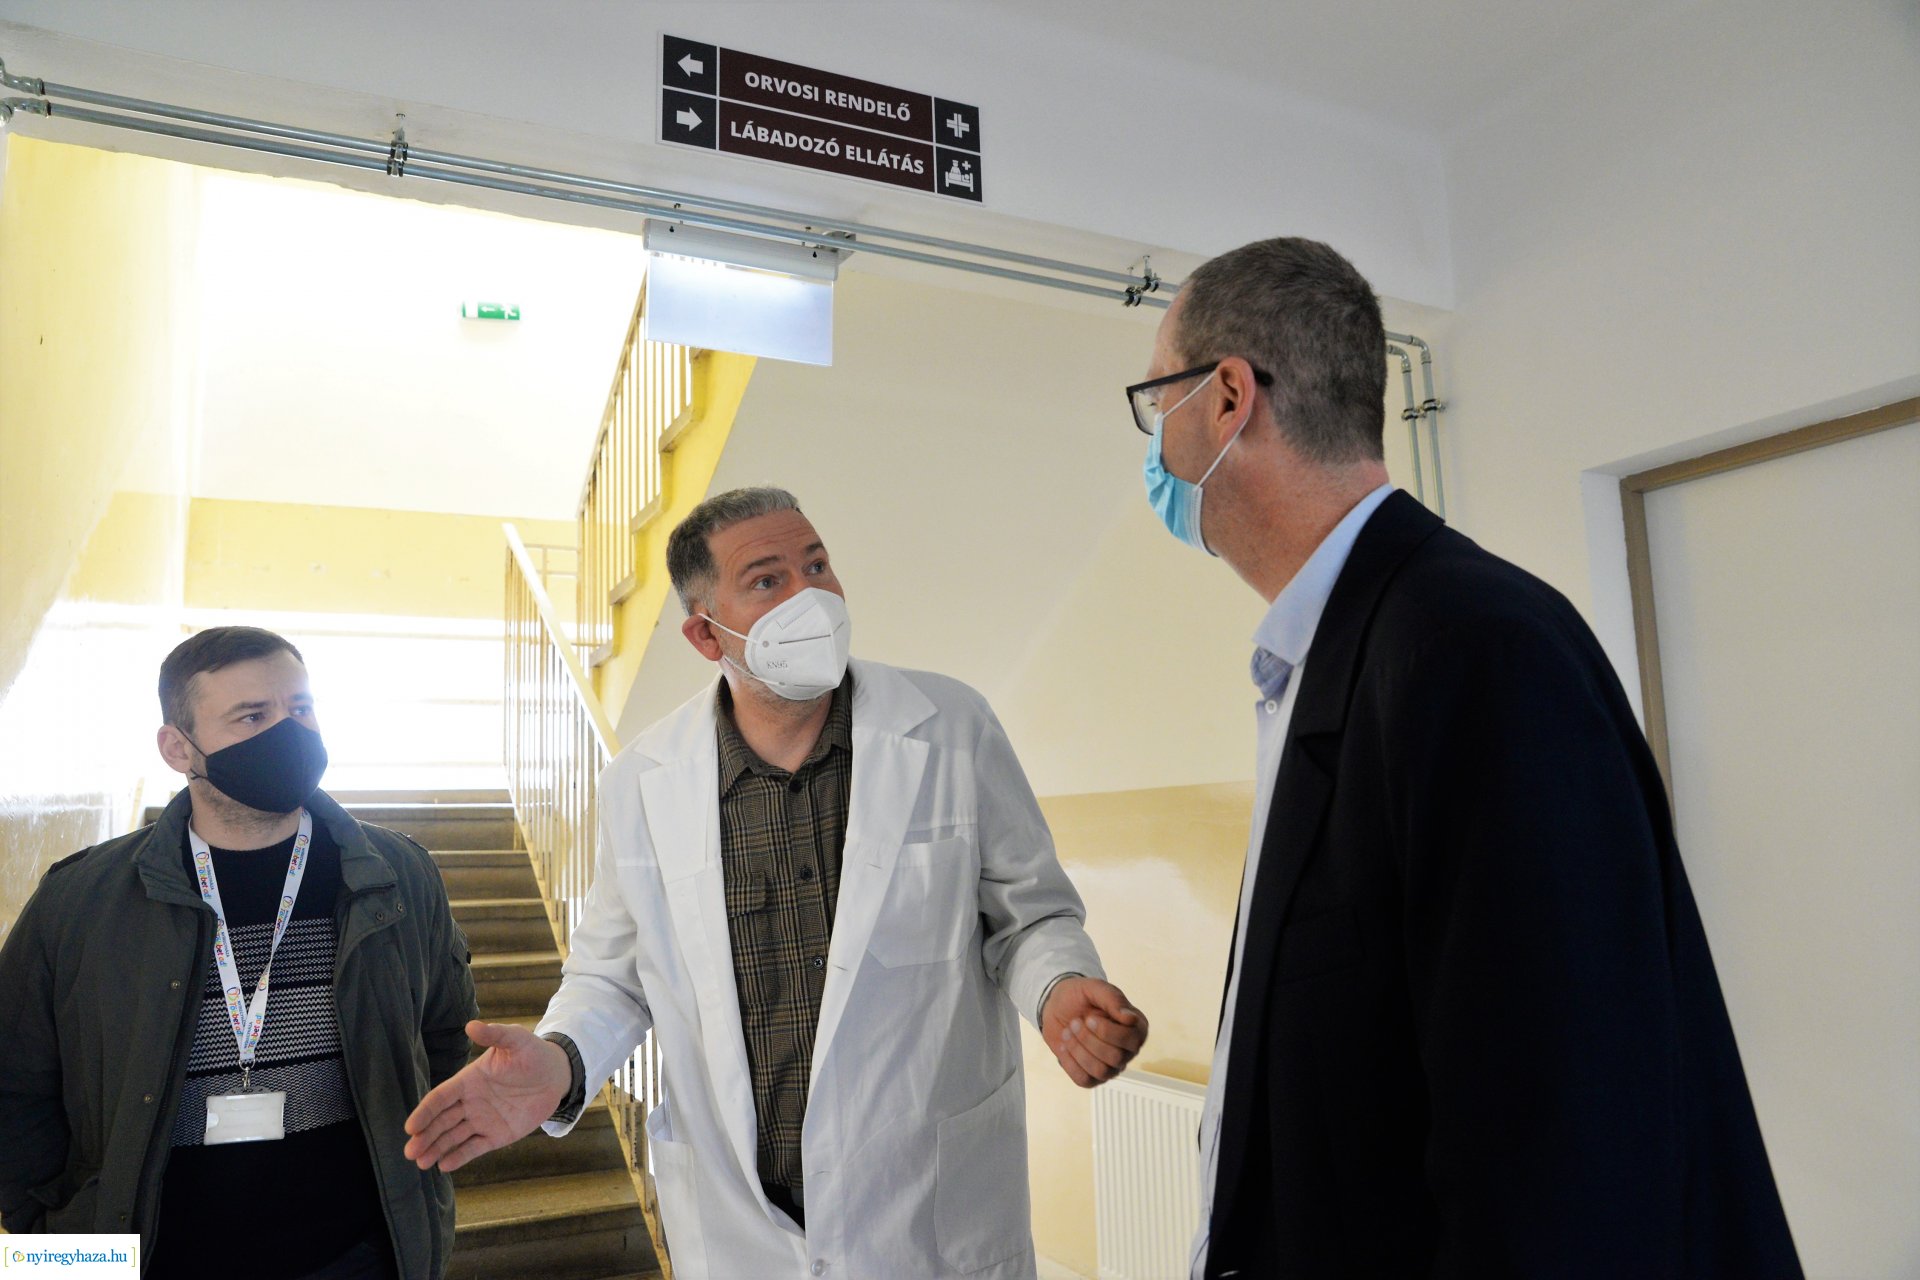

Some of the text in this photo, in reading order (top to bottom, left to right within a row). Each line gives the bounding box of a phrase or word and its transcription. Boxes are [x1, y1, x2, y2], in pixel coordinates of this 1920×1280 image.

[744, 71, 911, 122] ORVOSI RENDELŐ
[730, 119, 924, 175] LÁBADOZÓ ELLÁTÁS
